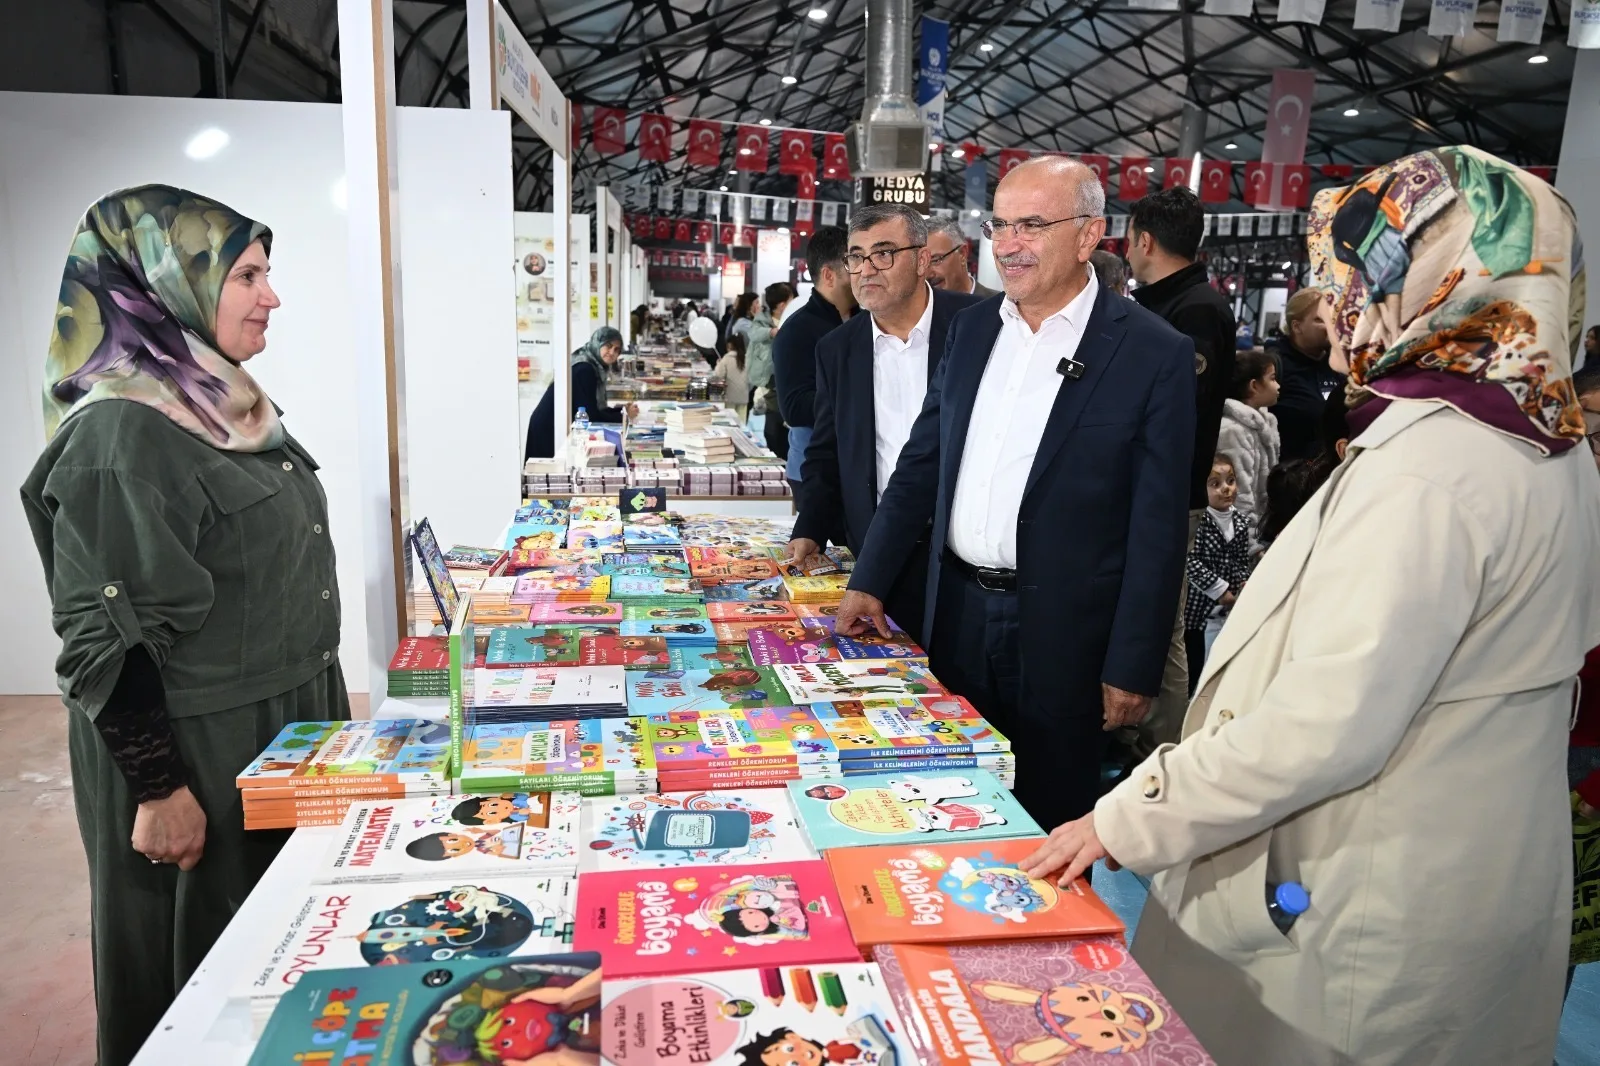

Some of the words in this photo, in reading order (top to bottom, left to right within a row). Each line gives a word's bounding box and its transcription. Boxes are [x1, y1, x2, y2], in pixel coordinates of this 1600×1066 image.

[873, 176, 925, 190] MEDYA
[873, 190, 926, 204] GRUBU
[321, 732, 355, 762] ZITLIKLARI
[530, 732, 550, 761] SAYILARI
[882, 748, 924, 756] KELİMELERİMİ
[926, 745, 970, 754] ÖĞRENİYORUM
[708, 760, 738, 768] RENKLERİ
[740, 758, 787, 766] ÖĞRENİYORUM
[884, 760, 928, 768] KELİMELERİMİ
[929, 758, 974, 767] ÖĞRENİYORUM
[552, 774, 604, 783] ÖĞRENİYORUM
[742, 768, 789, 776] ÖĞRENİYORUM
[288, 778, 327, 786] ZITLIKLARI
[328, 776, 382, 784] ÖĞRENİYORUM
[745, 779, 786, 787] ÖĞRENİYORU
[294, 789, 333, 797] ZITLIKLARI
[336, 786, 389, 796] ÖĞRENİYORUM
[348, 806, 394, 867] MATEMATİK
[334, 857, 346, 868] ZEKA
[888, 858, 944, 926] boyama
[636, 881, 682, 956] boyama
[282, 895, 352, 986] OYUNLAR
[311, 986, 358, 1045] ÇÖPE
[614, 1004, 626, 1028] Dikkat
[634, 1012, 647, 1048] Geliştiren
[656, 1001, 686, 1058] Boyama
[682, 986, 712, 1065] Etkinlikleri
[618, 1030, 626, 1038] ve
[614, 1040, 627, 1059] Zeka
